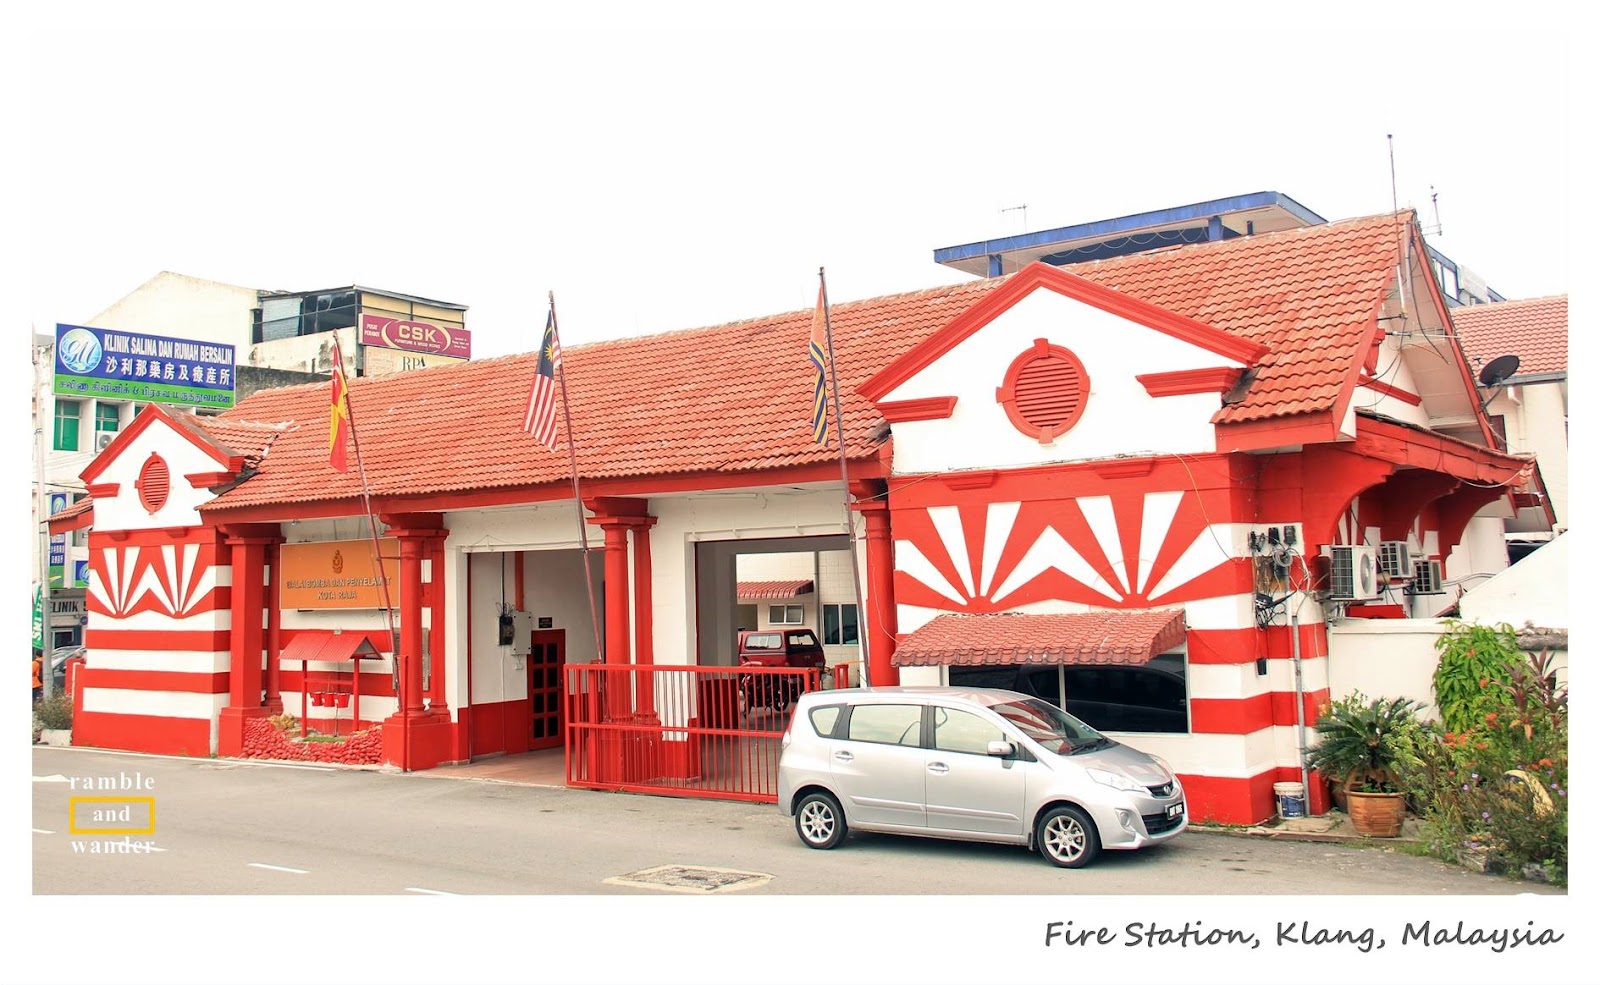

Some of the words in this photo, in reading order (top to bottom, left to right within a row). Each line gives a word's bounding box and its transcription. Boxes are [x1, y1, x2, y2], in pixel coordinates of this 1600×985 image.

[398, 325, 437, 343] CSK
[103, 334, 130, 354] KLINIK
[130, 337, 158, 357] SALINA
[158, 340, 174, 360] DAN
[174, 342, 199, 362] RUMAH
[200, 345, 233, 366] BERSALIN
[307, 579, 331, 589] BOMBA
[331, 579, 345, 588] DAN
[346, 577, 391, 587] PENYELAMT
[318, 591, 336, 600] KOTA
[338, 591, 357, 600] RAJA
[49, 601, 79, 613] LINIK
